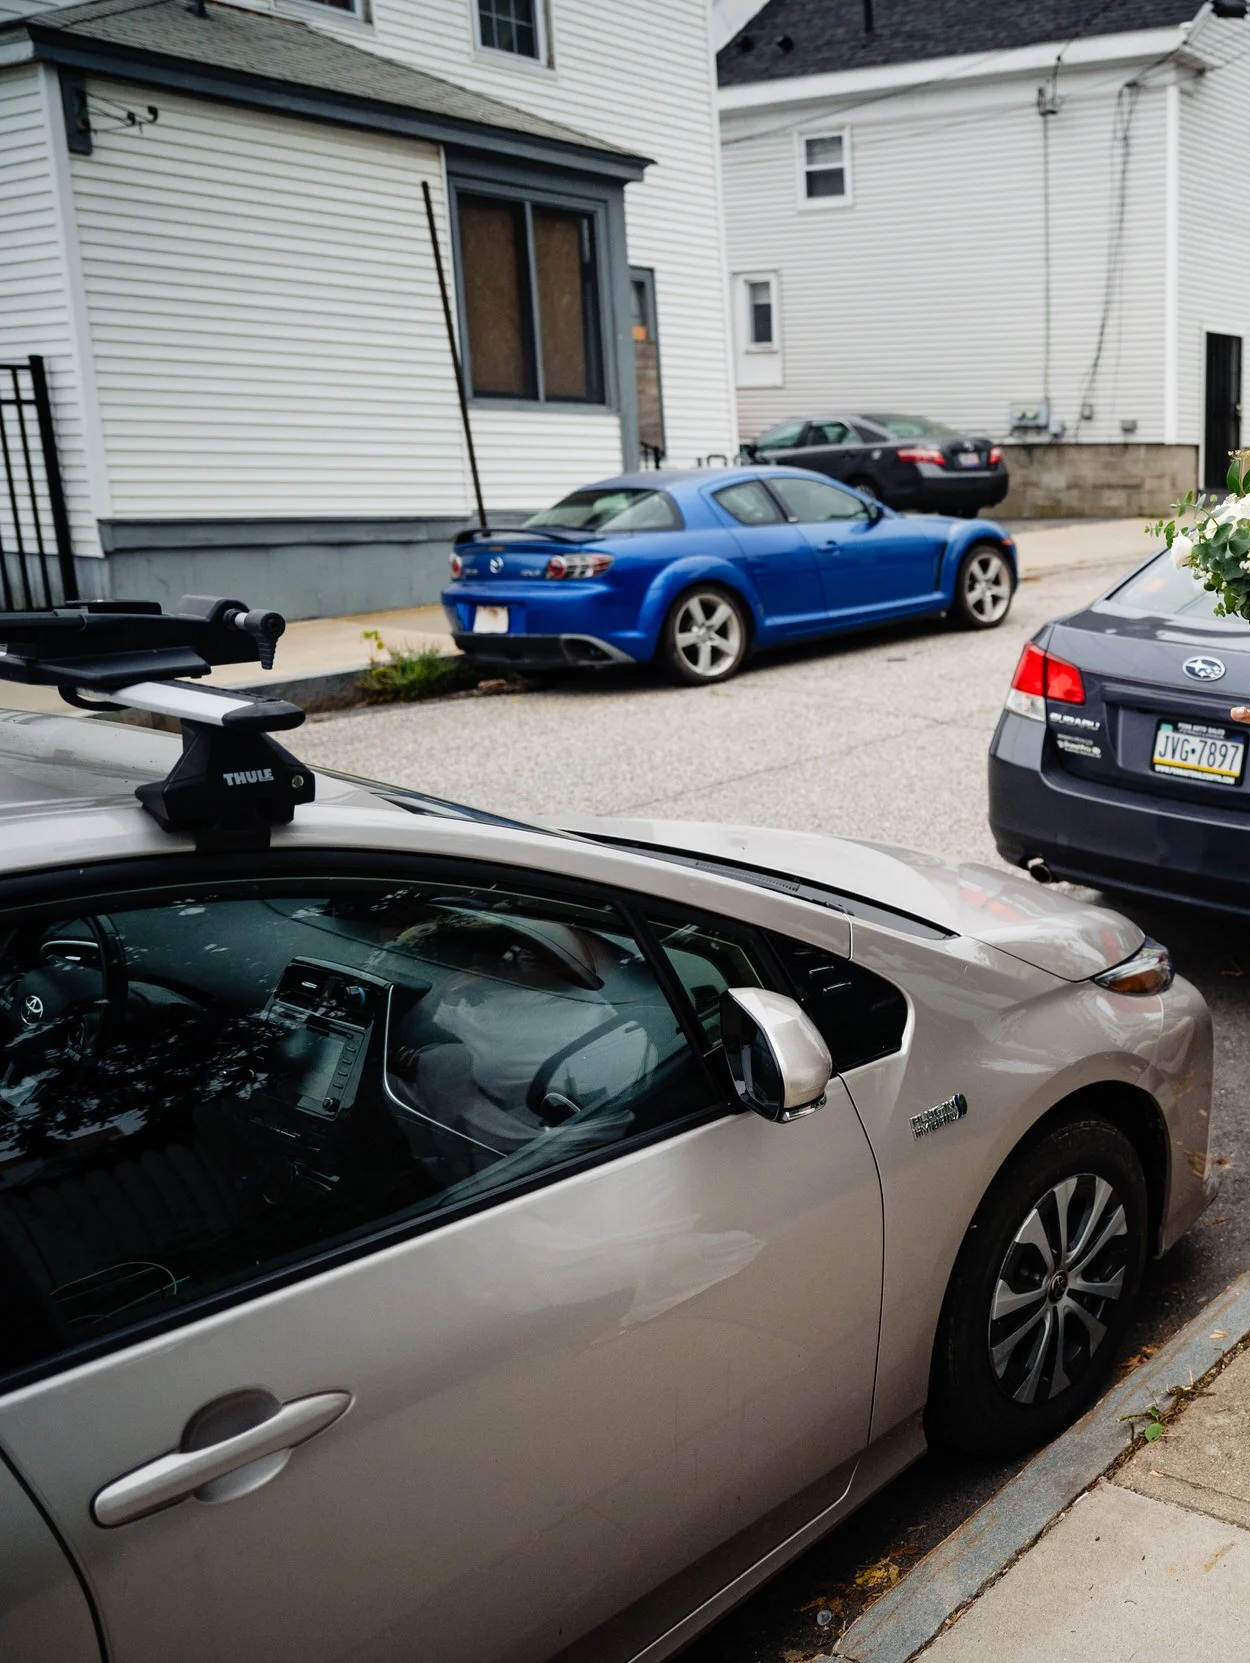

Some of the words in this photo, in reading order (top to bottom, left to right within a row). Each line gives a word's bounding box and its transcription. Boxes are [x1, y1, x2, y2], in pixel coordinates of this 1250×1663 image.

[1049, 711, 1100, 731] SUBARU
[222, 768, 274, 787] THULE
[913, 1112, 957, 1140] HYBRID
